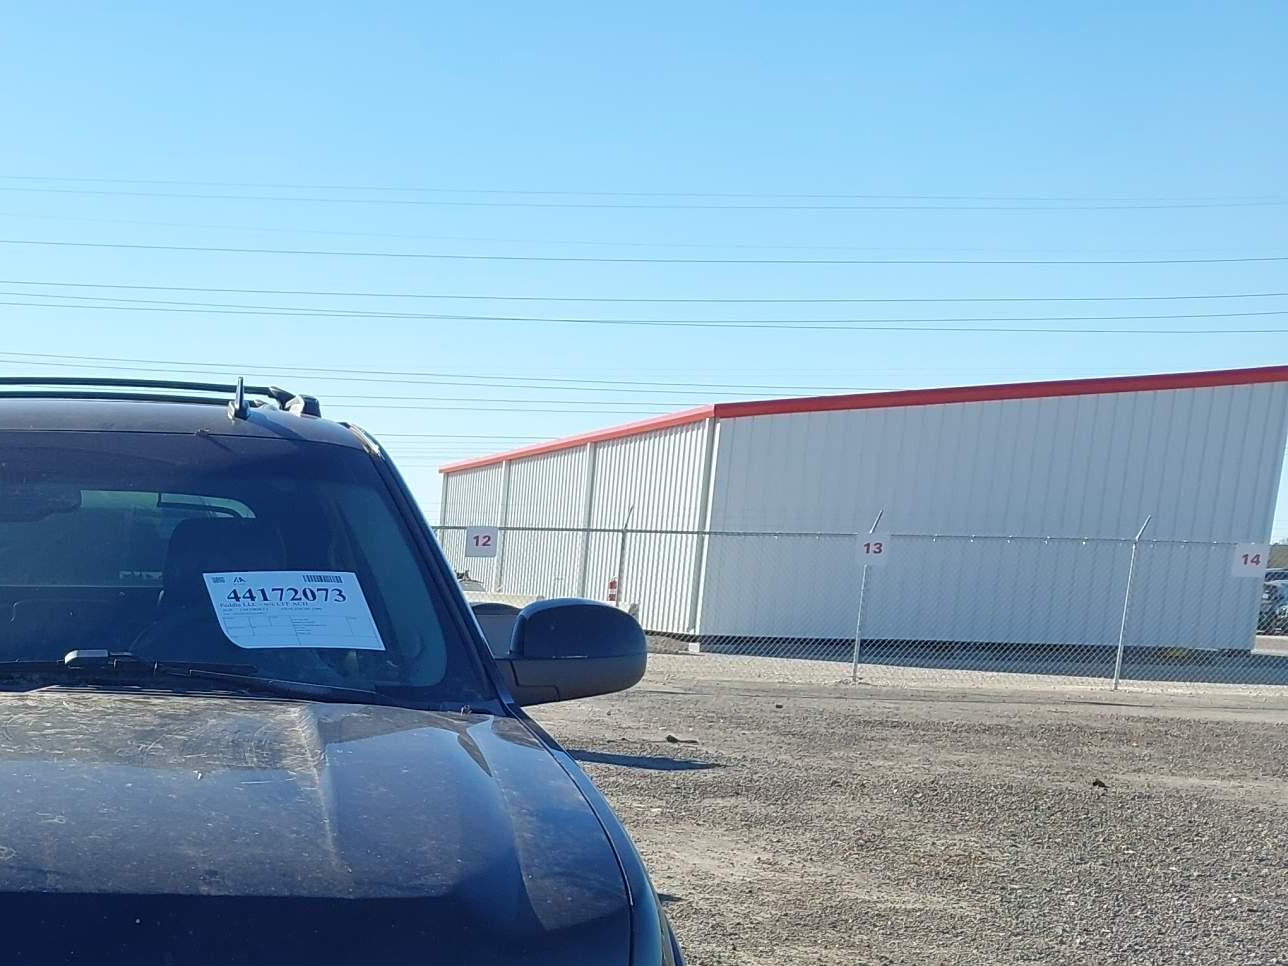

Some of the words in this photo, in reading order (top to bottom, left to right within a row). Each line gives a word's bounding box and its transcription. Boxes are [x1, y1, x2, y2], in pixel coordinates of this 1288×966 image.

[472, 535, 492, 547] 12
[863, 542, 883, 555] 13
[1241, 553, 1261, 566] 14
[226, 587, 347, 603] 44172073
